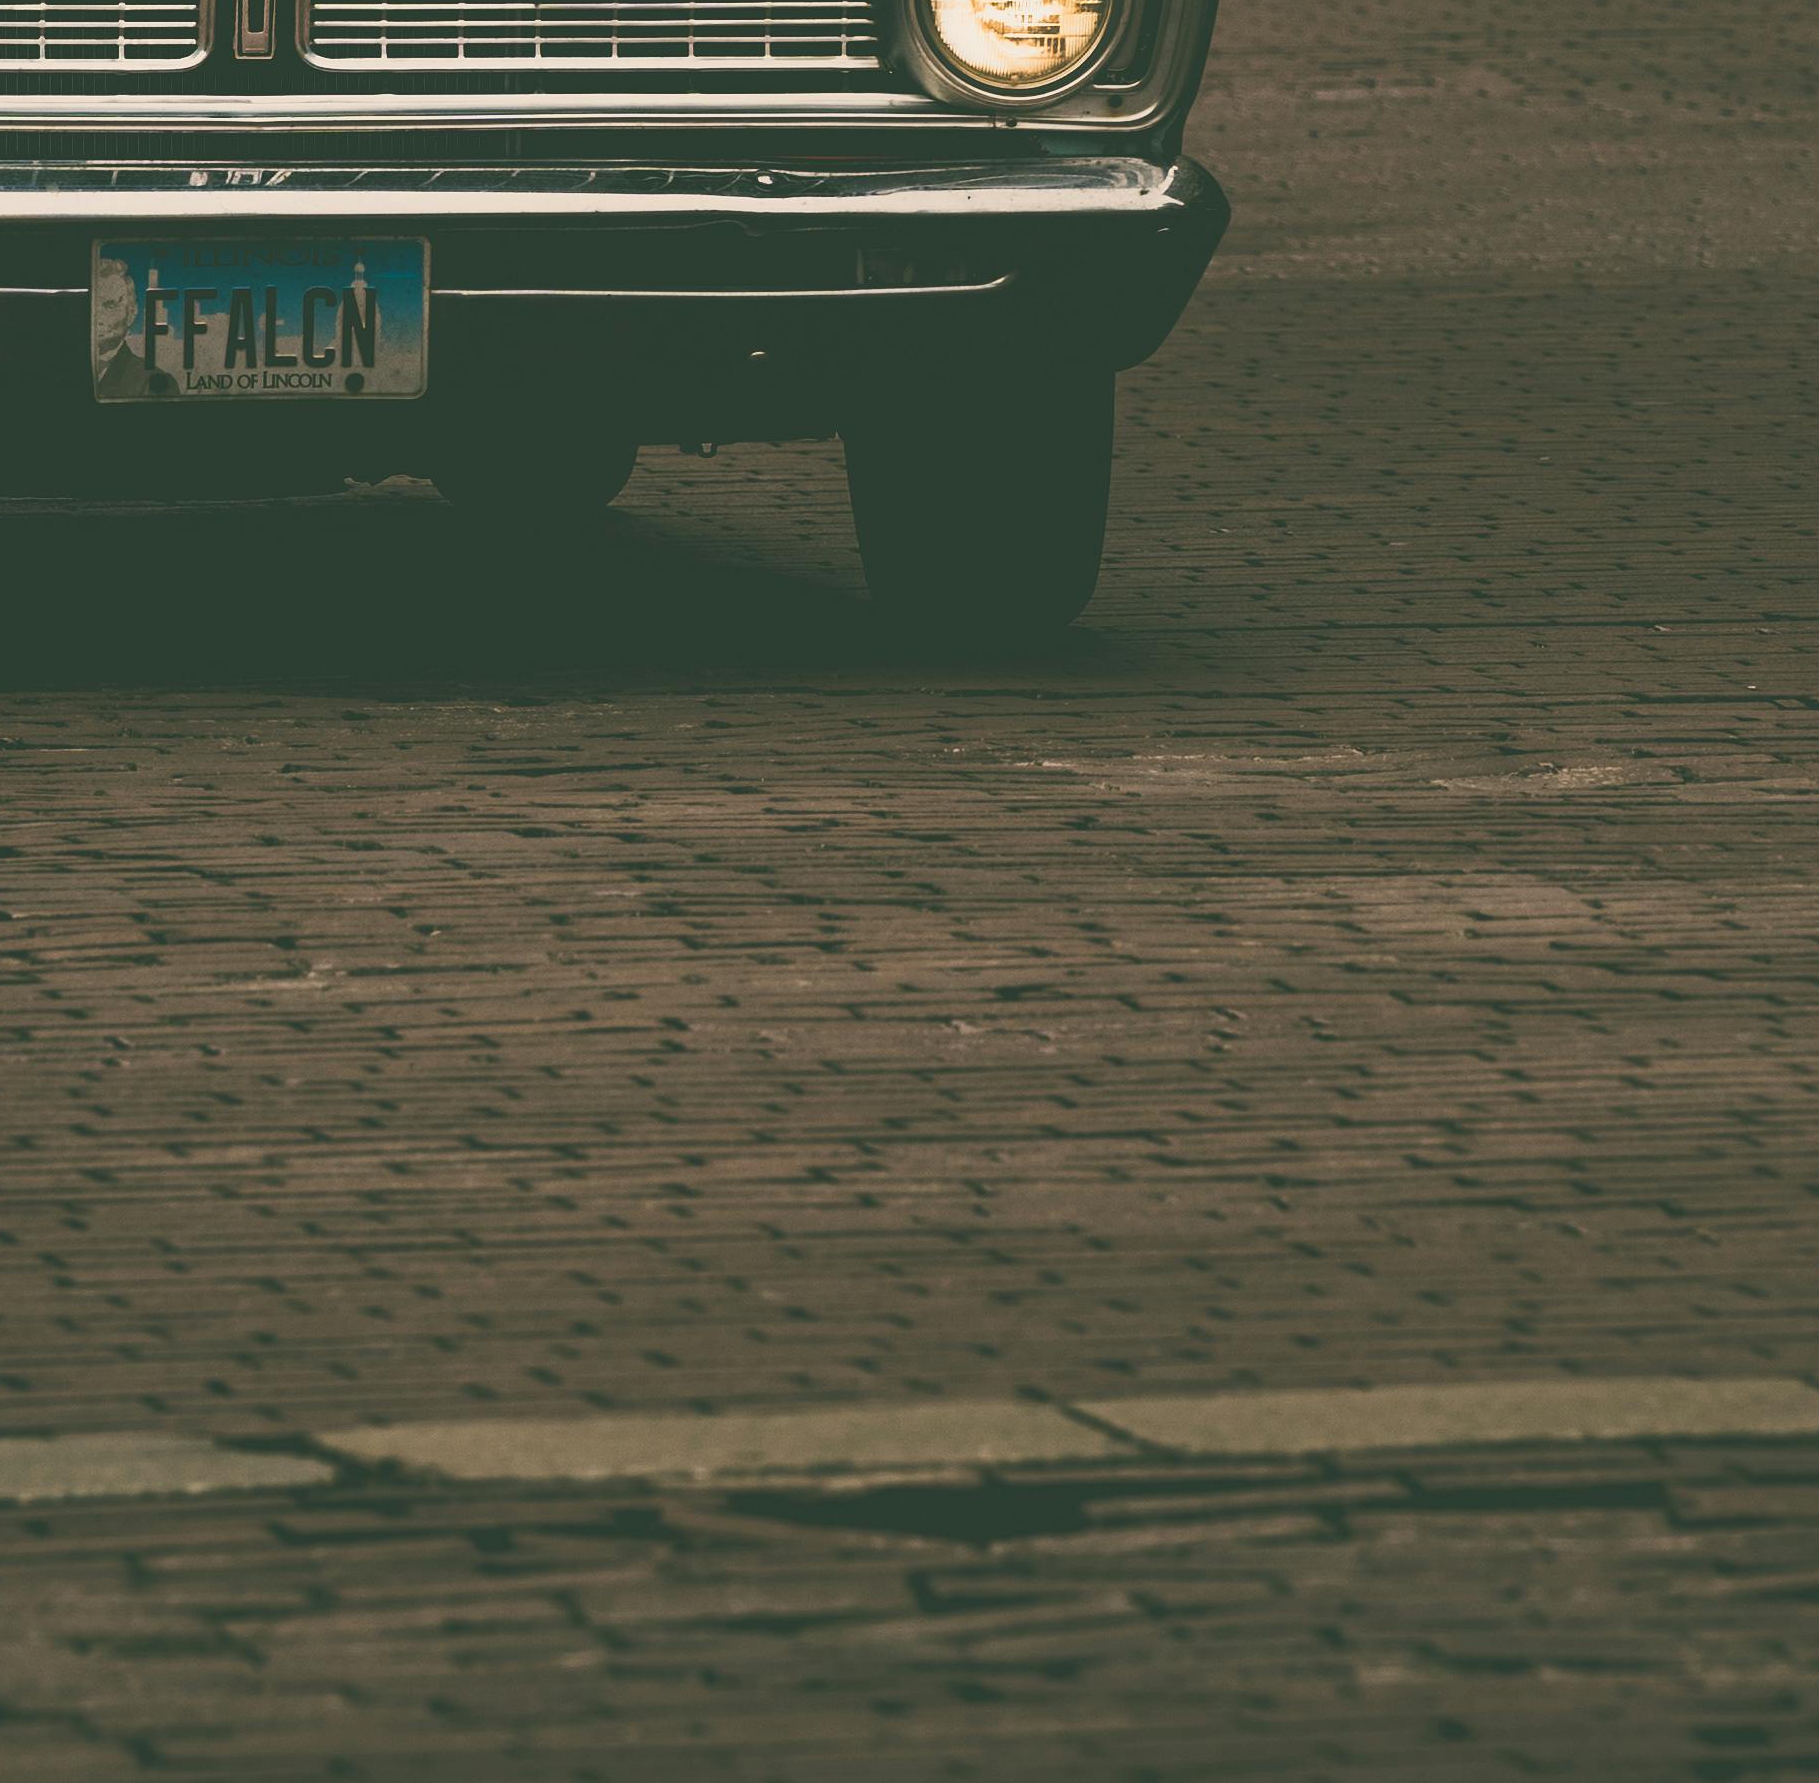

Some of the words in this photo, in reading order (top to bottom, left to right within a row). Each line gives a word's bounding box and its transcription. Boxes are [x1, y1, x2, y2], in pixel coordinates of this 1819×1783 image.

[184, 248, 343, 267] ILLINOIS
[144, 286, 377, 369] FFALCN
[186, 372, 232, 389] LAND
[236, 374, 258, 389] OF
[262, 371, 332, 389] LINCOLN
